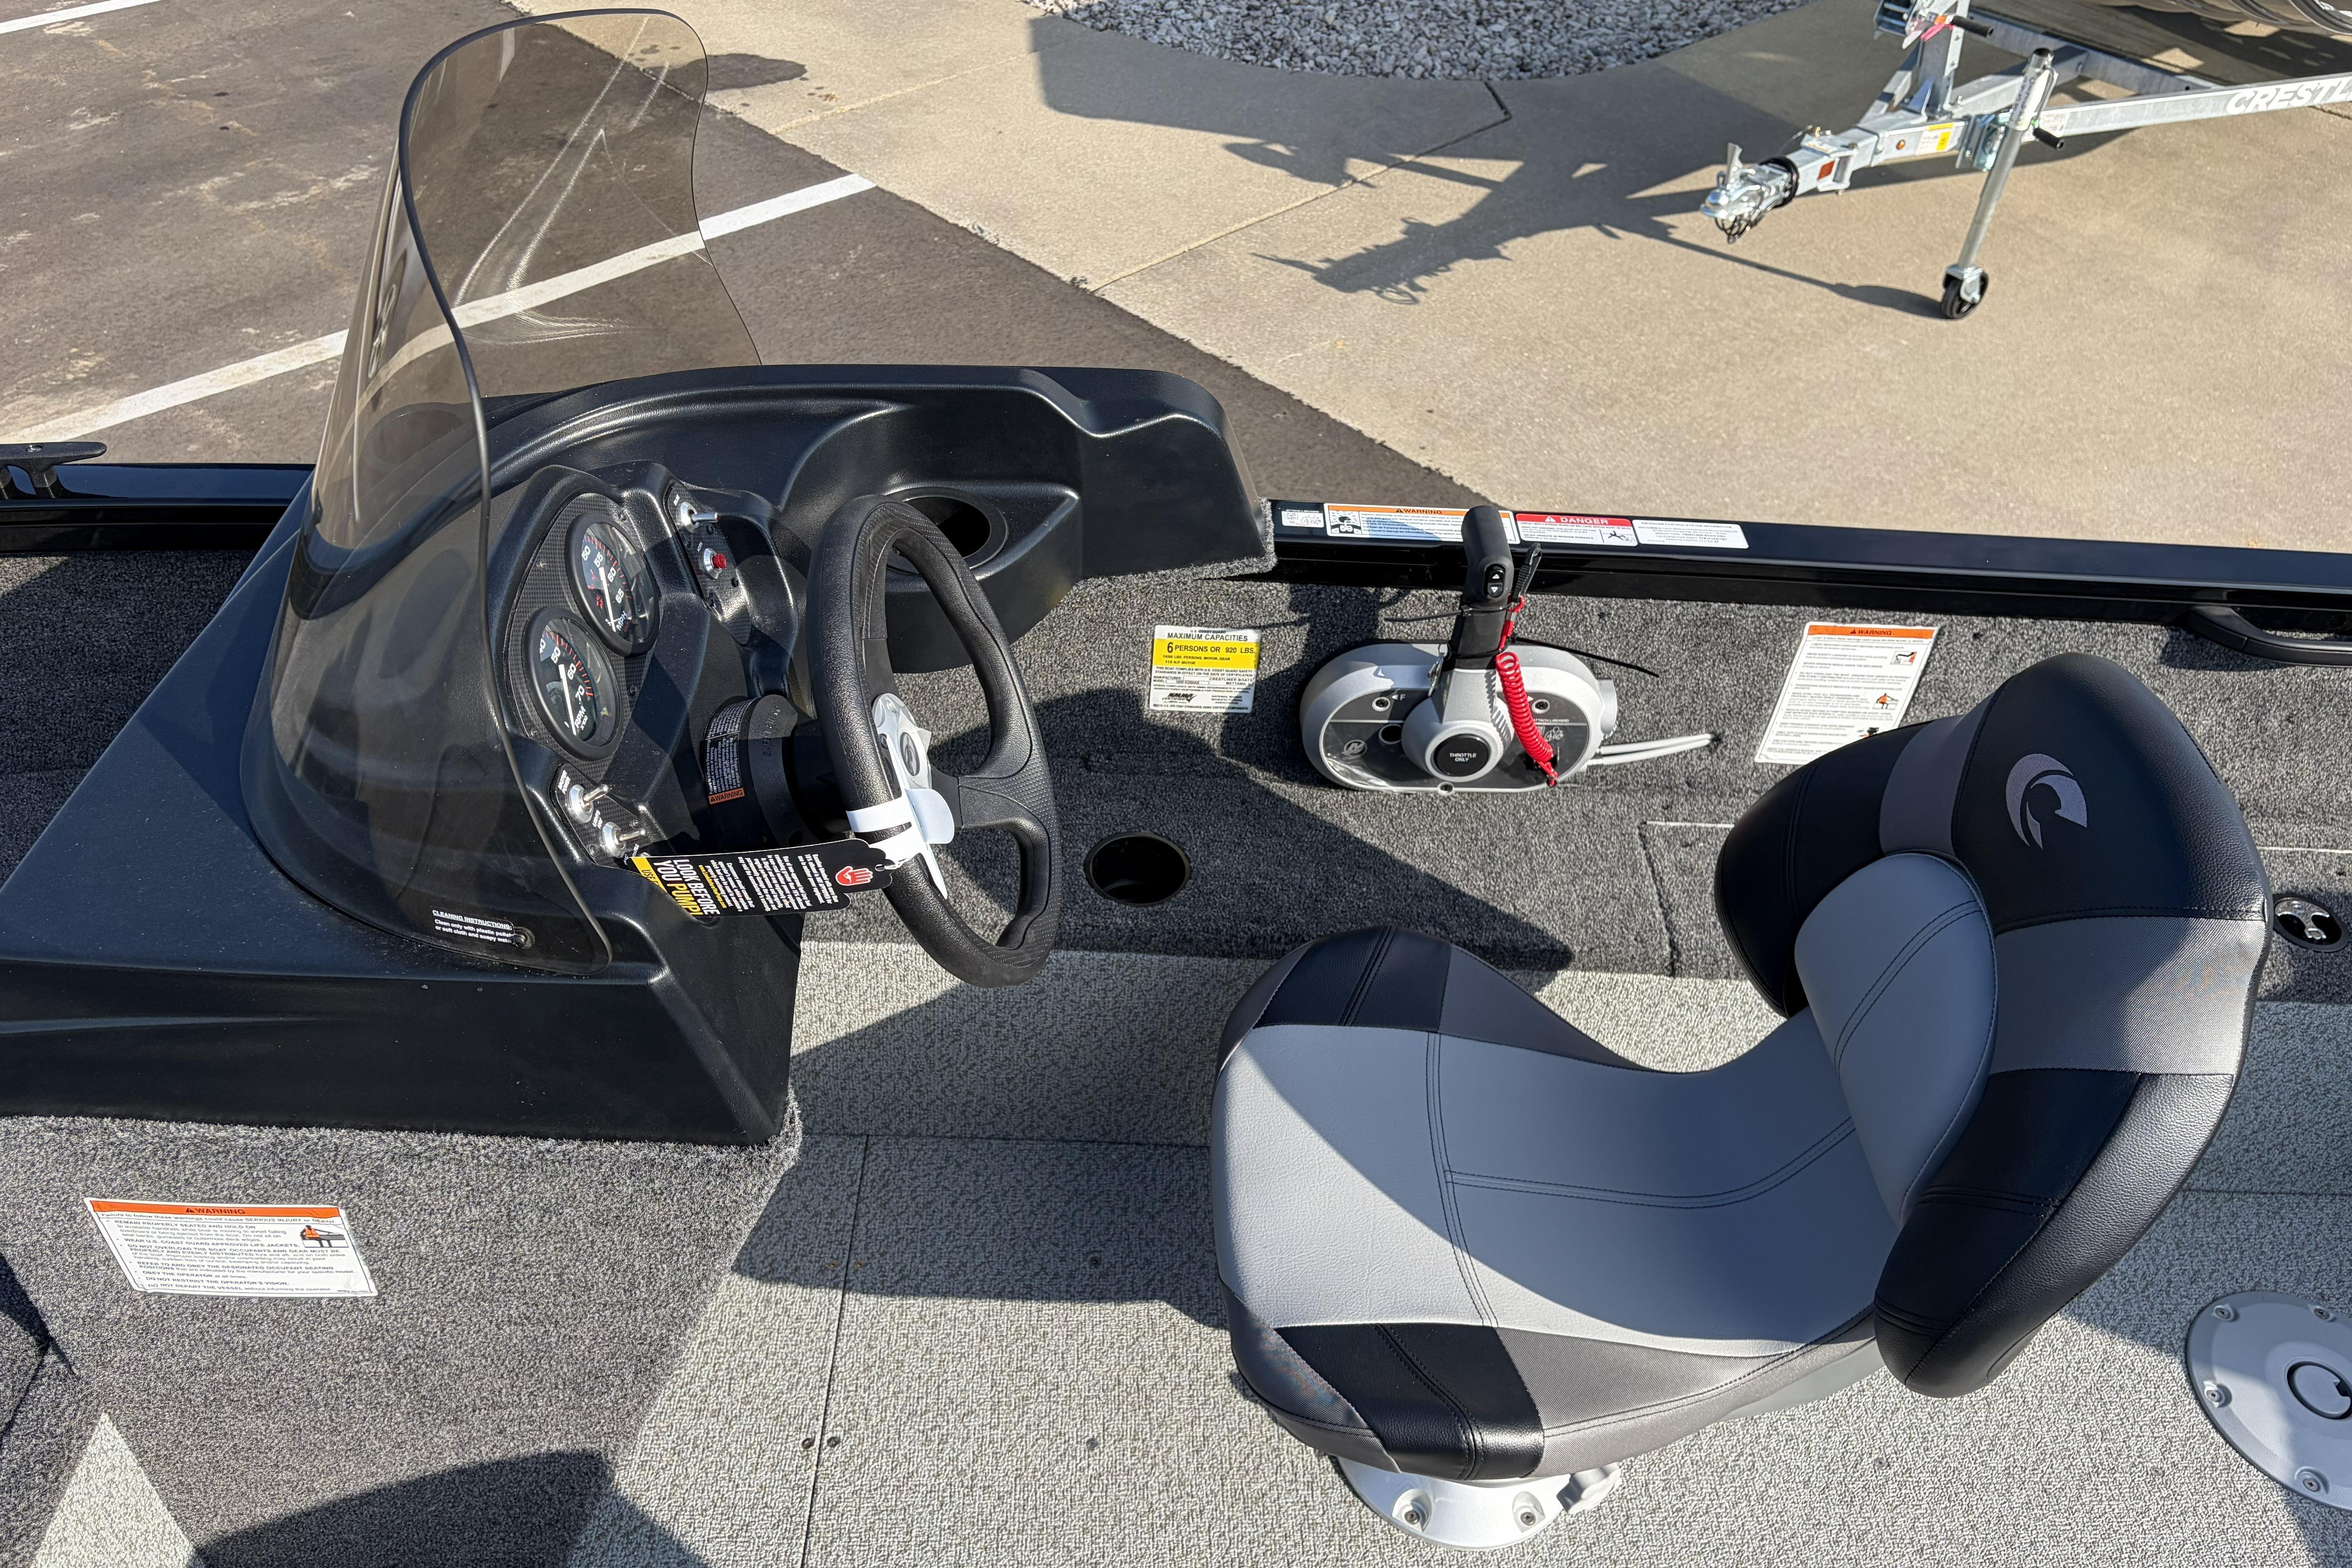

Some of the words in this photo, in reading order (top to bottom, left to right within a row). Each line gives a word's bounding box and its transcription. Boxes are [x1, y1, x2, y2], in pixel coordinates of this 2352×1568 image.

[581, 545, 591, 561] 50
[593, 552, 603, 568] 55
[607, 567, 616, 582] 60
[615, 588, 624, 604] 65
[616, 610, 628, 631] MPH
[1204, 633, 1248, 642] CAPACITIES
[551, 646, 561, 663] 50
[1167, 642, 1174, 653] 6
[567, 663, 576, 679] 60
[575, 685, 585, 701] 70
[574, 705, 586, 728] RPM
[715, 789, 743, 800] WARNING
[652, 861, 682, 881] YOU
[672, 859, 700, 881] LOOK
[686, 882, 720, 915] BEFORE
[818, 883, 831, 899] APPROVED
[666, 883, 703, 917] PUMP!
[432, 910, 463, 921] CLEANING
[464, 916, 512, 930] INSTRUCTIONS:
